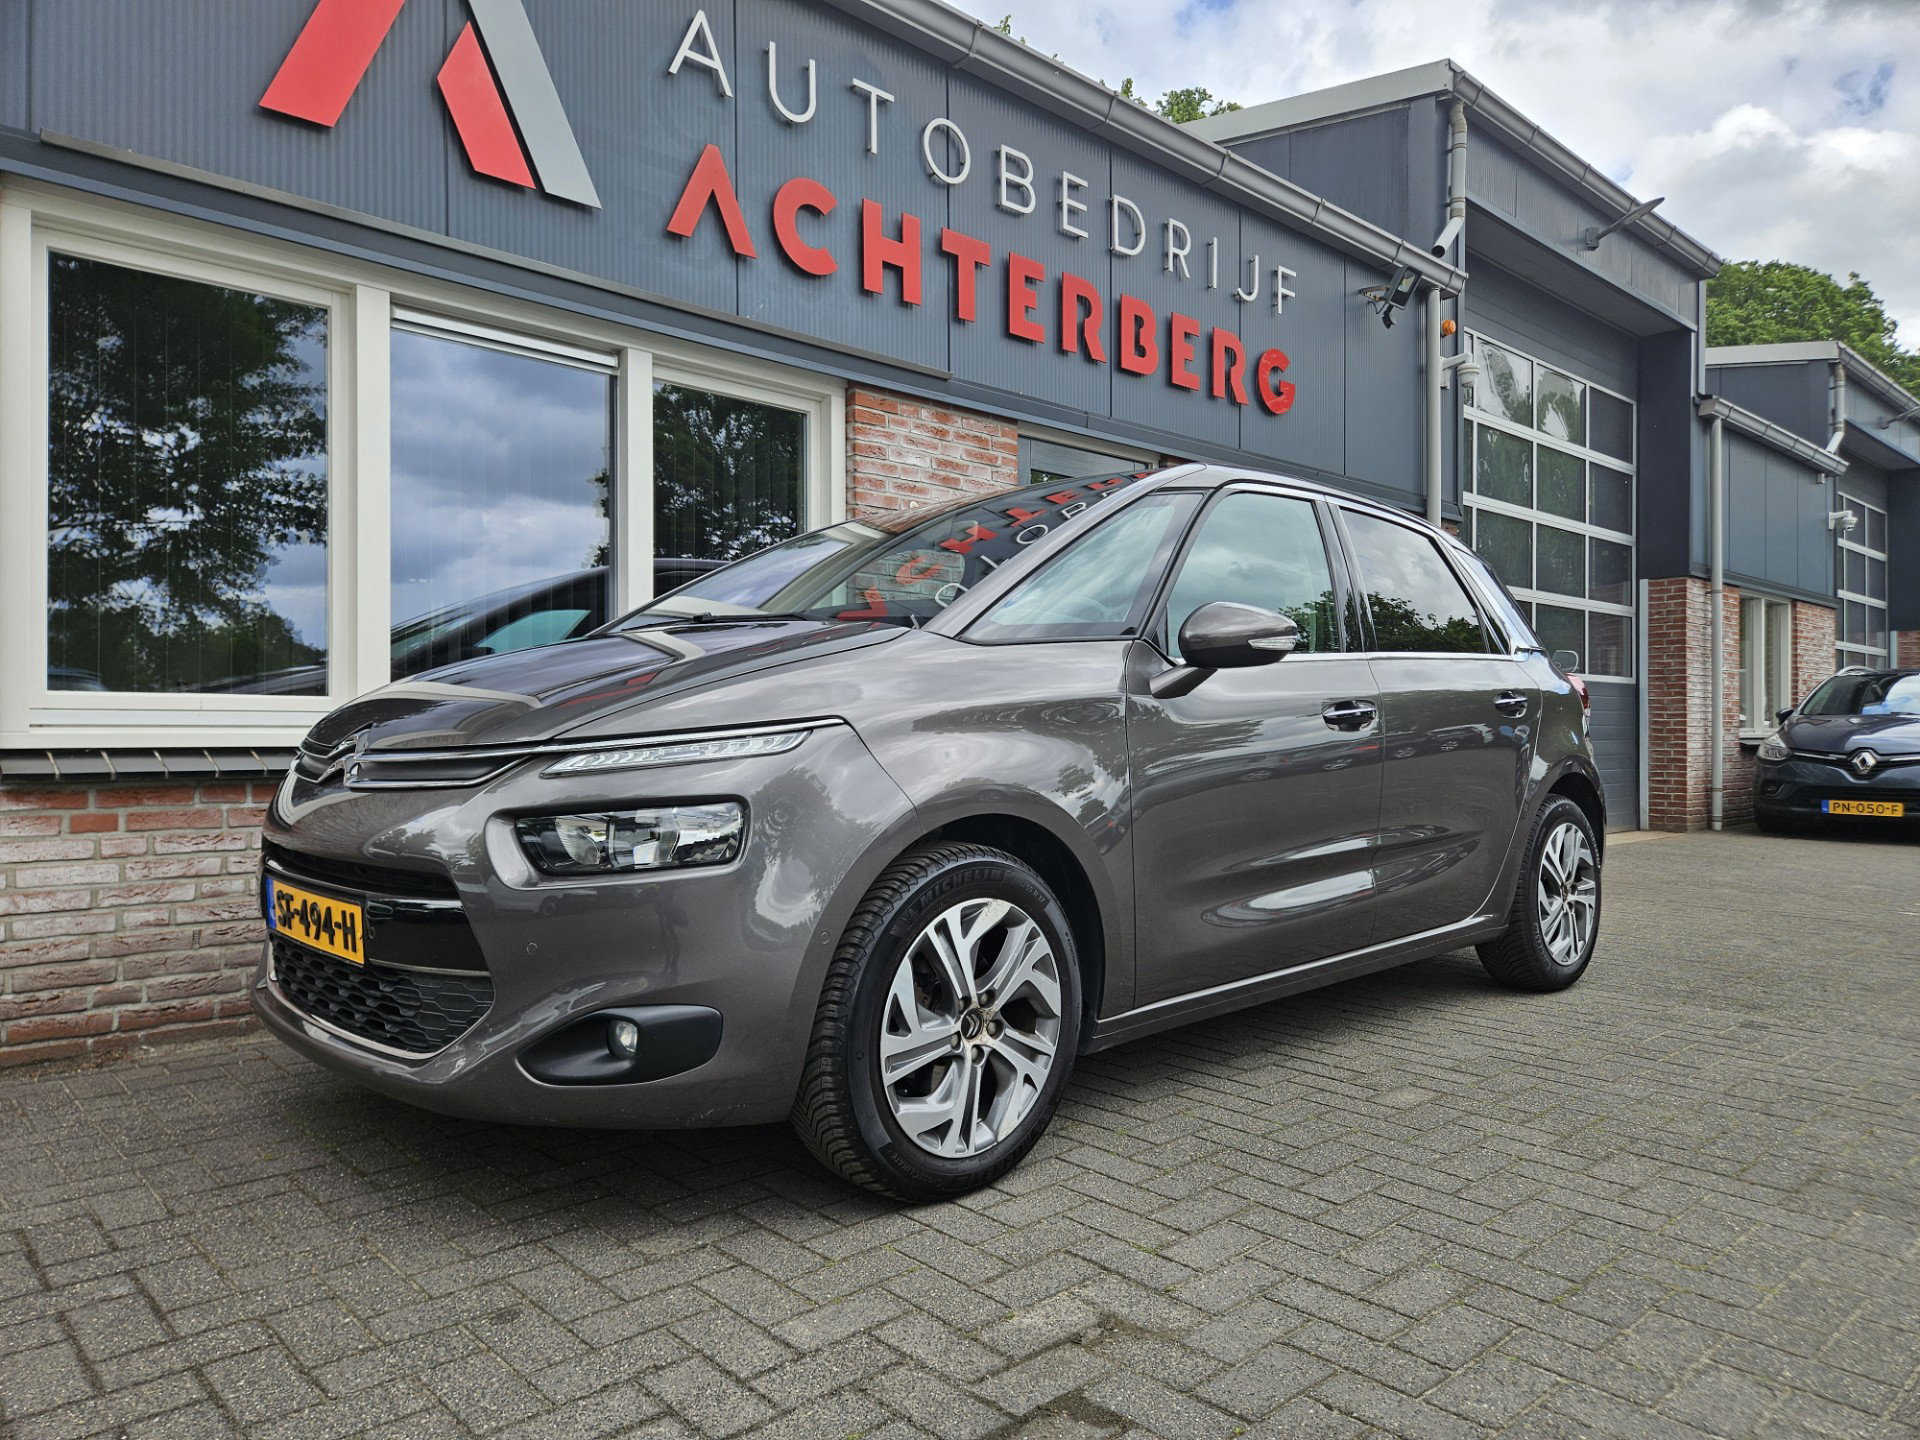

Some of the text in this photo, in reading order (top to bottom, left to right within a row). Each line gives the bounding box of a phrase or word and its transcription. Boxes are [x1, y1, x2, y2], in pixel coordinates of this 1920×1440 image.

[667, 9, 1297, 314] AUTOBEDRIJF
[667, 143, 1296, 416] ACHTERBERG
[1833, 802, 1899, 814] PN-050-F
[276, 890, 357, 953] SF-494-H
